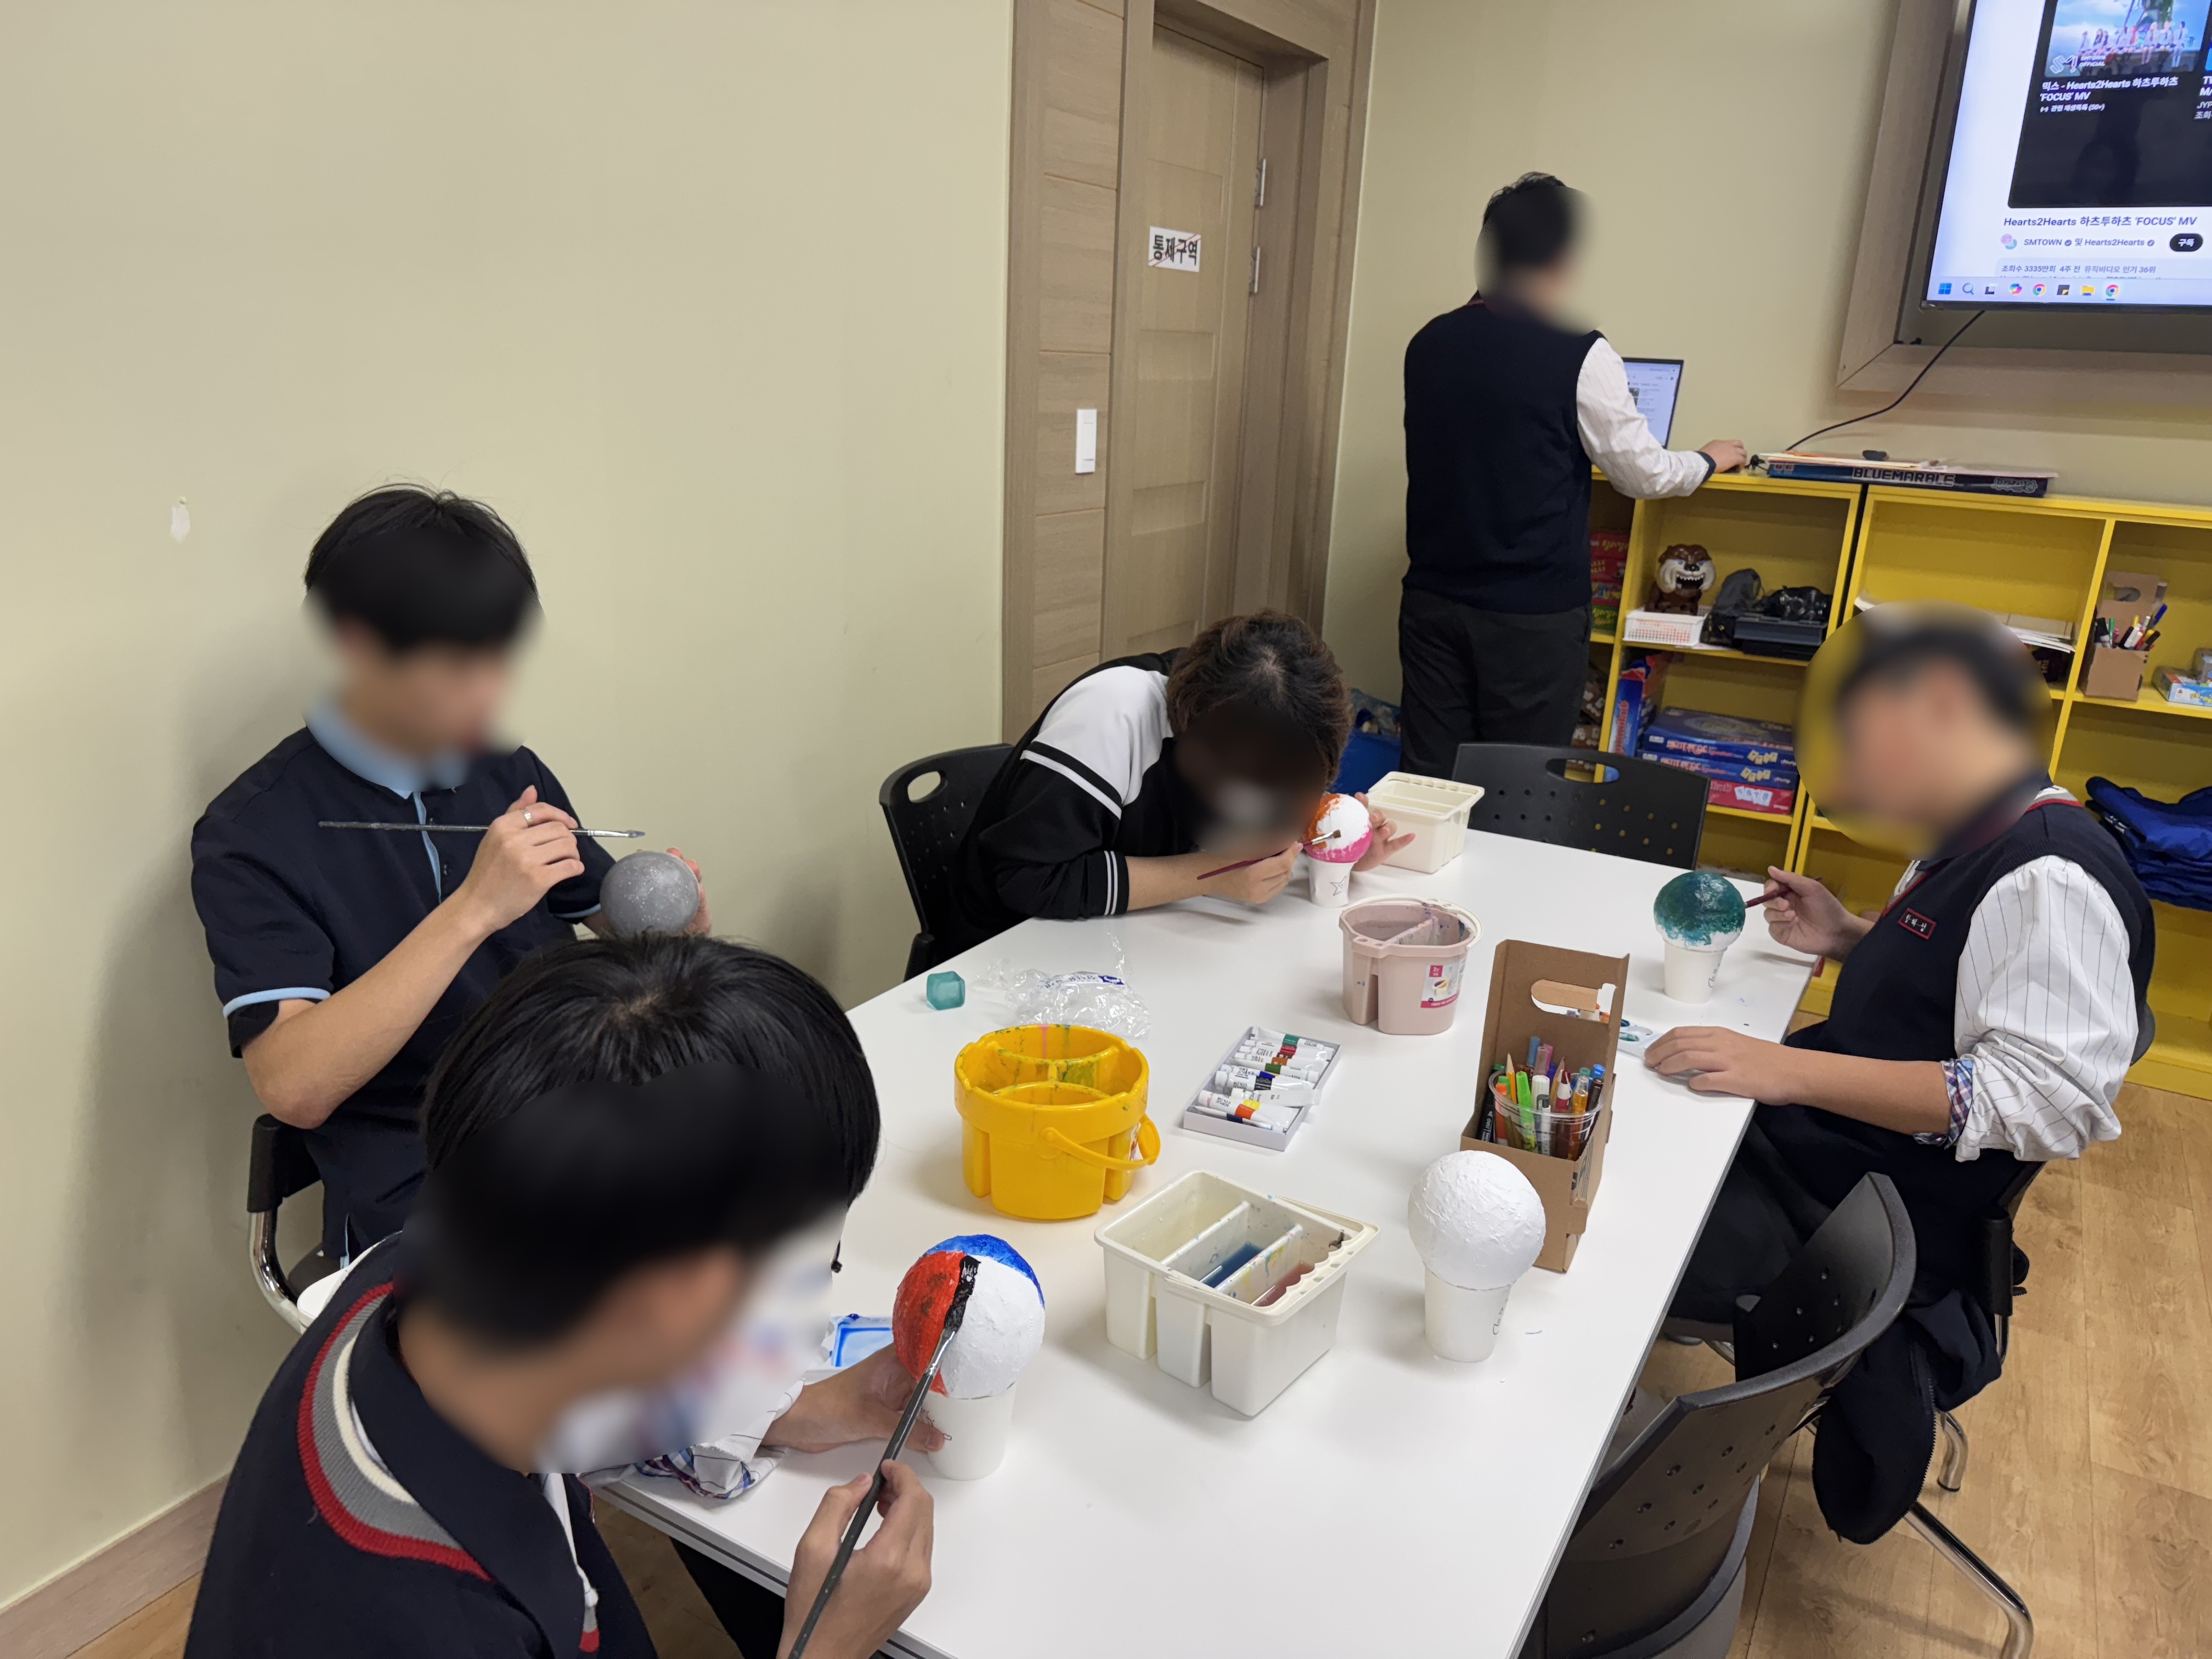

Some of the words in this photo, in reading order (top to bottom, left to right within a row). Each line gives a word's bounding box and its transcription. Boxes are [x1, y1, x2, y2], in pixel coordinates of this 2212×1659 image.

[2066, 80, 2131, 90] Hearts2Hearts
[2132, 76, 2179, 88] 하츠투하츠
[2074, 92, 2091, 100] MV
[2004, 218, 2076, 226] Hearts2Hearts
[2080, 216, 2132, 227] 하츠투하츠
[2135, 216, 2176, 225] 'FOCUS'
[2178, 217, 2198, 225] MV
[2075, 238, 2083, 246] 및
[2177, 238, 2195, 247] 구독
[1153, 235, 1198, 266] 통제구역
[2084, 265, 2120, 273] 뮤직비디오
